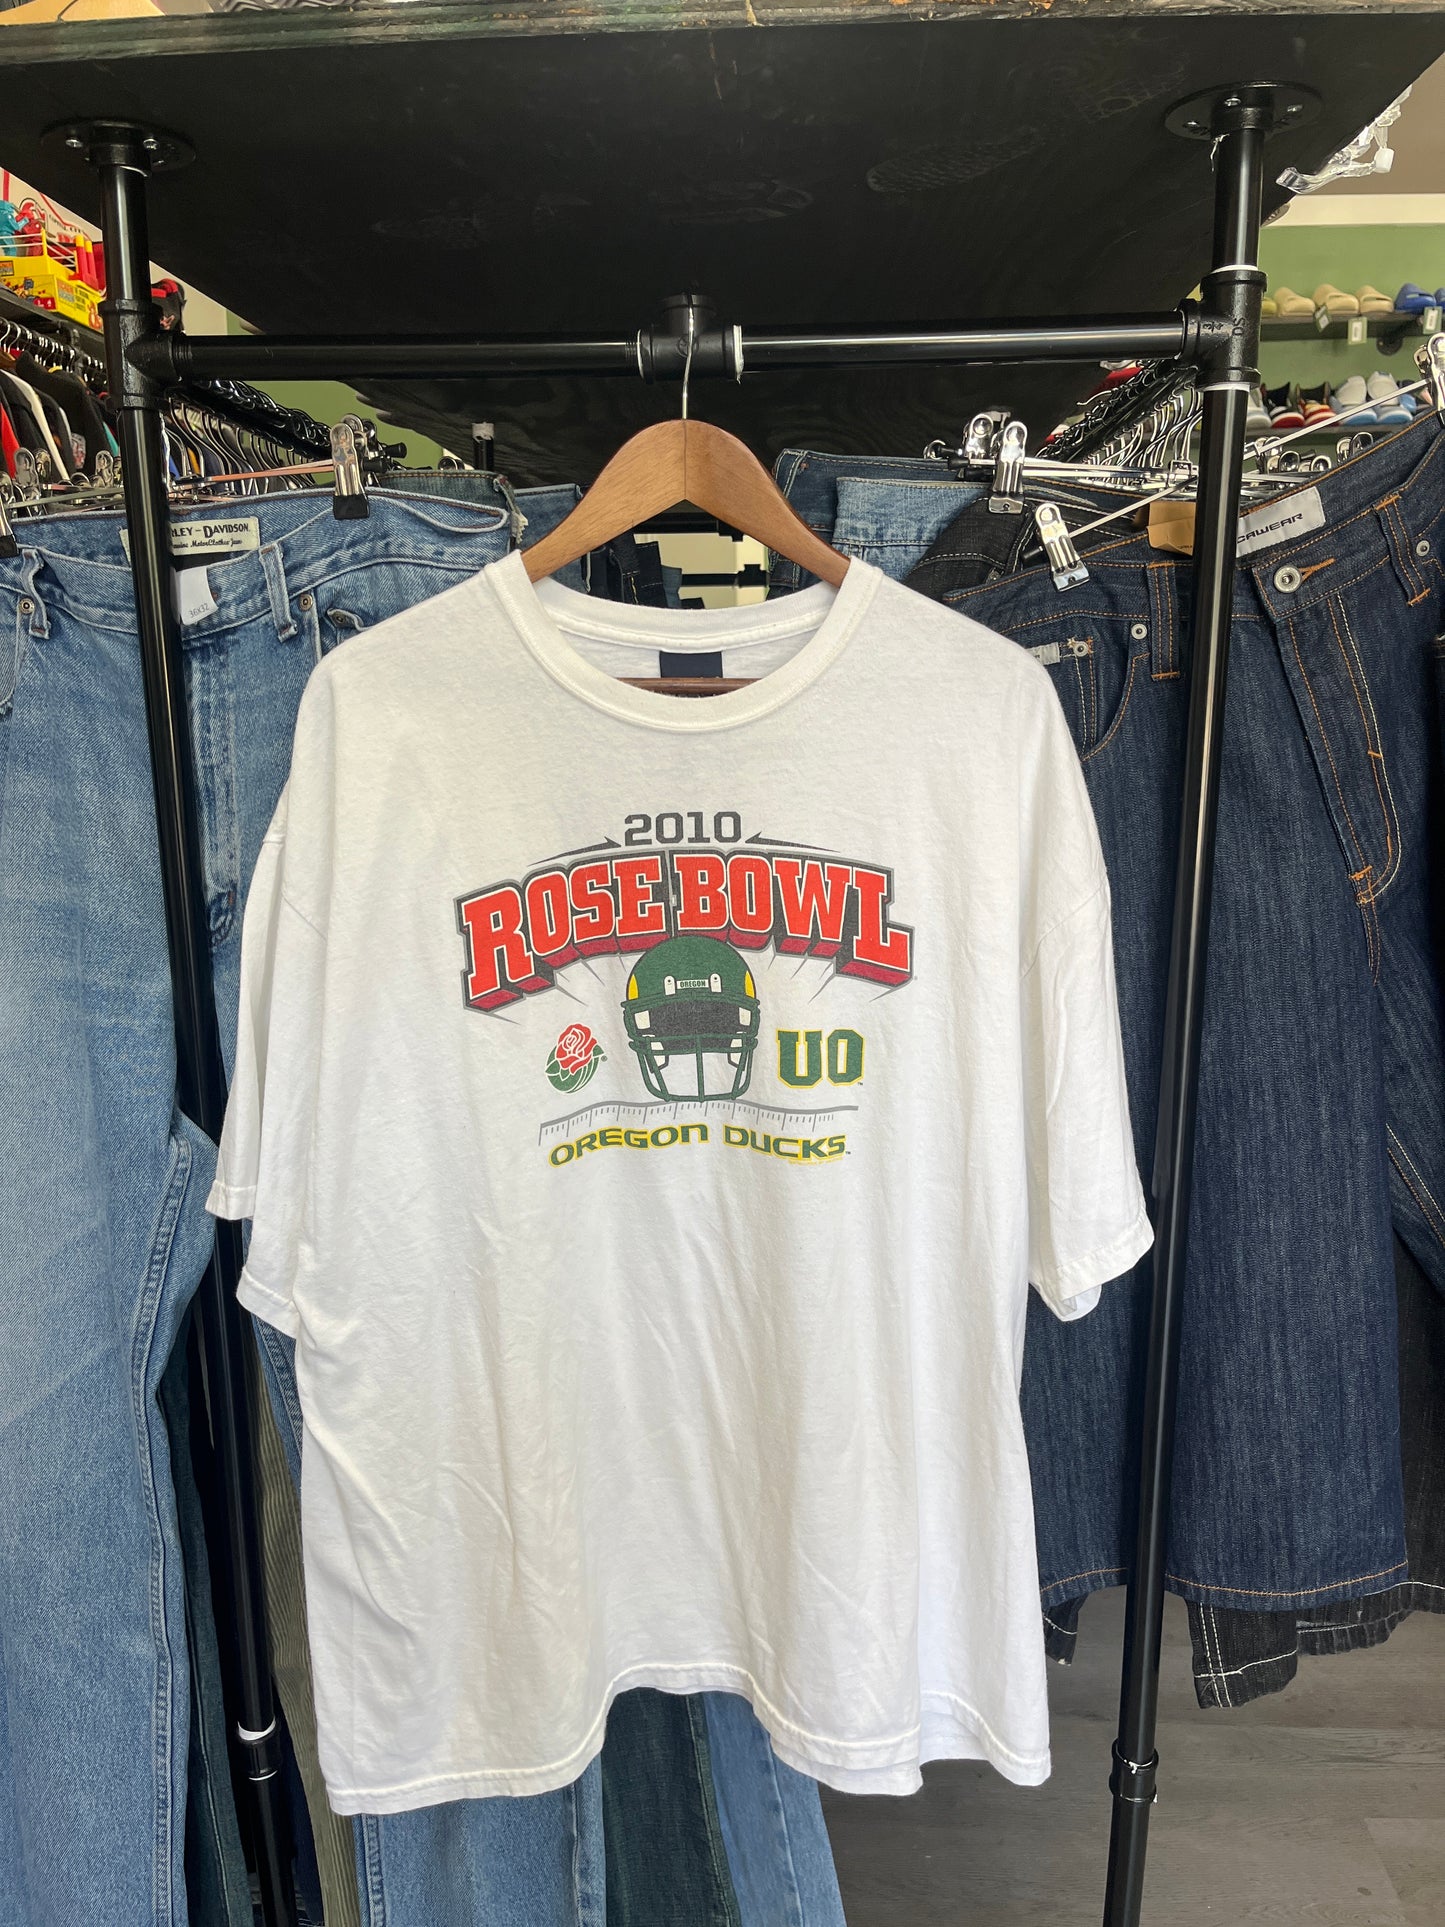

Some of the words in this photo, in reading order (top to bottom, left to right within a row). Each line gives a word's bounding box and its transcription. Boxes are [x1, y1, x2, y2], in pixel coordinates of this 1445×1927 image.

[623, 811, 743, 846] 2010
[458, 853, 668, 1006] ROSE
[672, 850, 913, 978] BOWL
[679, 980, 706, 988] OREGON
[776, 1028, 865, 1089] UO
[548, 1122, 709, 1168] OREGON
[723, 1123, 847, 1161] DUCKS
